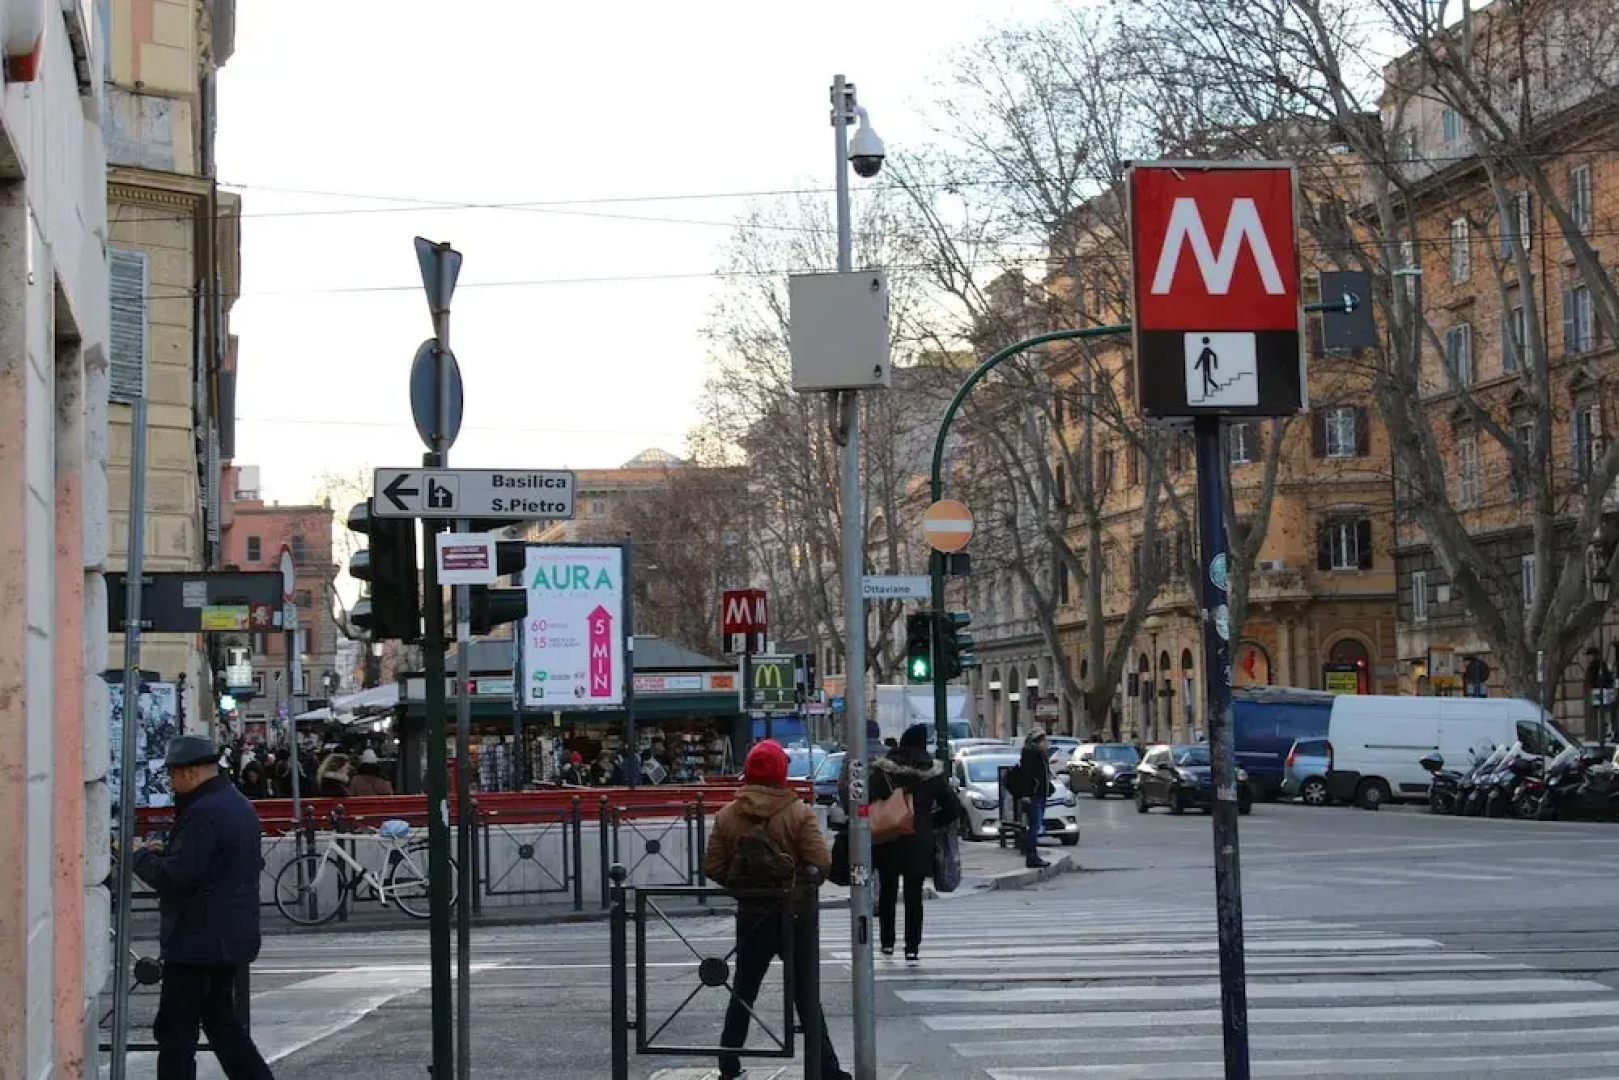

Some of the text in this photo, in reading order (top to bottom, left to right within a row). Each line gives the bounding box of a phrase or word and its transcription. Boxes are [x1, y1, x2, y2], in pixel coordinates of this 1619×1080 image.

[1150, 197, 1287, 295] M
[492, 474, 566, 488] Basilica
[492, 498, 566, 512] S.Pietro
[531, 564, 614, 590] AURA
[864, 584, 911, 594] Ottaviano
[725, 597, 752, 625] M
[531, 619, 548, 632] 60
[533, 636, 547, 648] 15
[592, 619, 608, 690] 5 MIN
